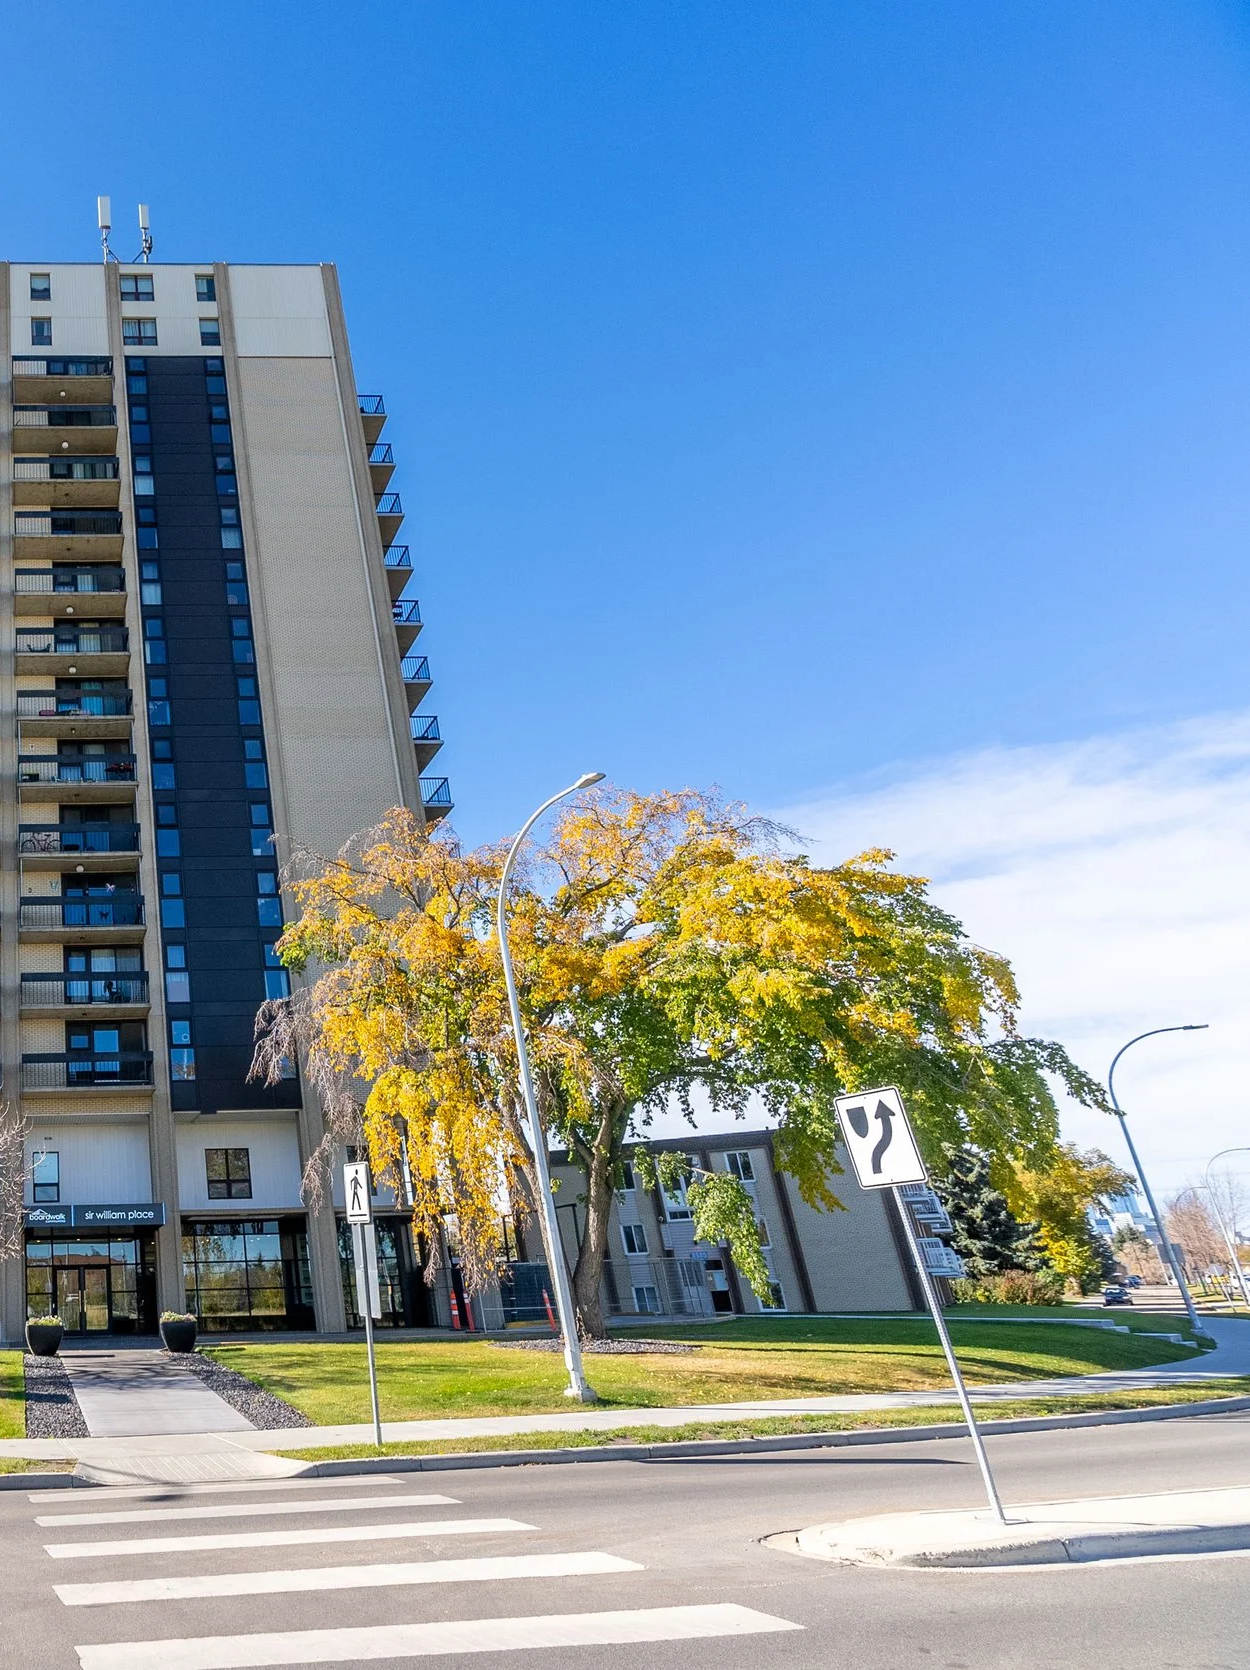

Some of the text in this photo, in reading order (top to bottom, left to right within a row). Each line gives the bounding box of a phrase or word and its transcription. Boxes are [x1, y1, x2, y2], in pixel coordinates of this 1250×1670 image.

[29, 1213, 66, 1221] boardwalk
[85, 1210, 154, 1221] sir william place
